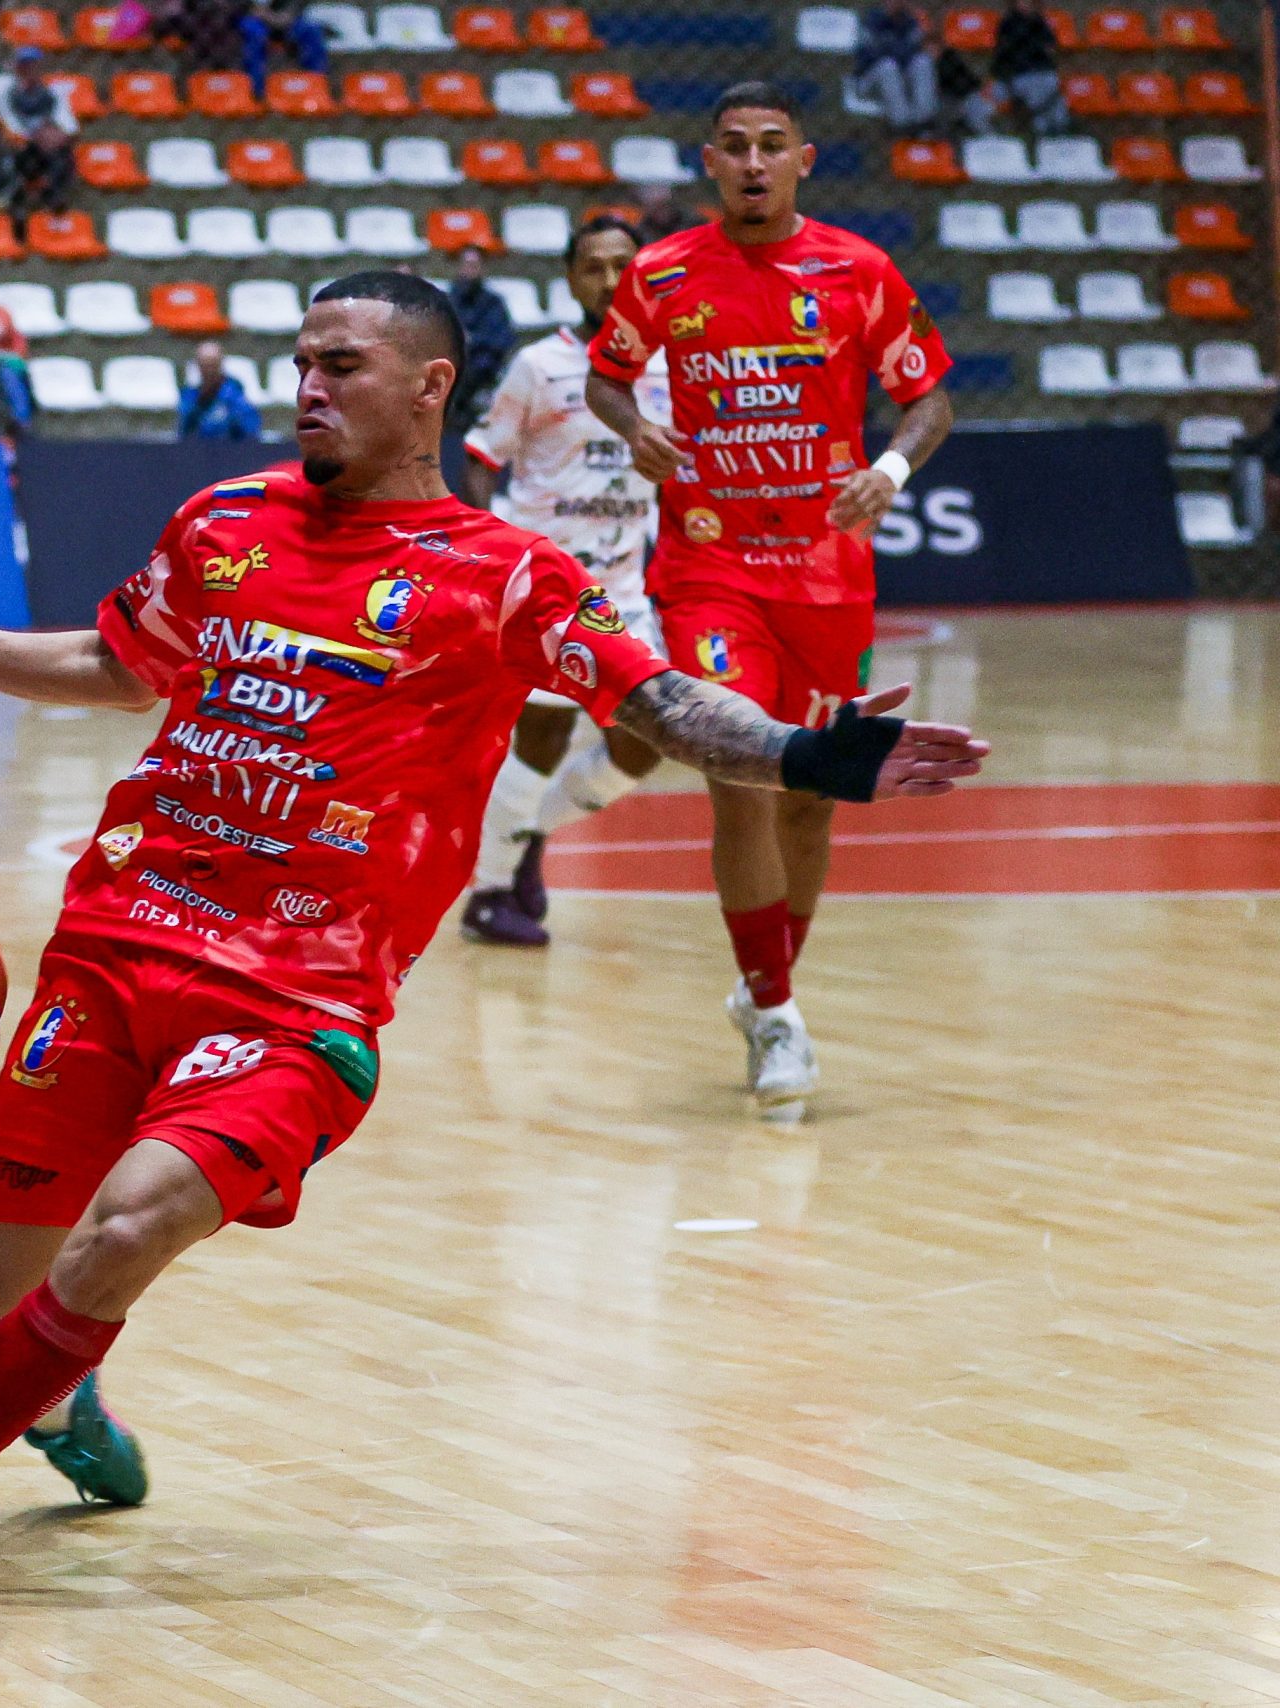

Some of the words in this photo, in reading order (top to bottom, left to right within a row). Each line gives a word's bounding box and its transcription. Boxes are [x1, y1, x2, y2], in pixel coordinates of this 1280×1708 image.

[680, 347, 780, 385] SENIAT
[736, 383, 802, 408] BDV
[227, 671, 327, 723] BDV
[168, 720, 324, 781] MultiMax
[137, 869, 237, 921] Plataorma
[271, 889, 330, 924] Rifel
